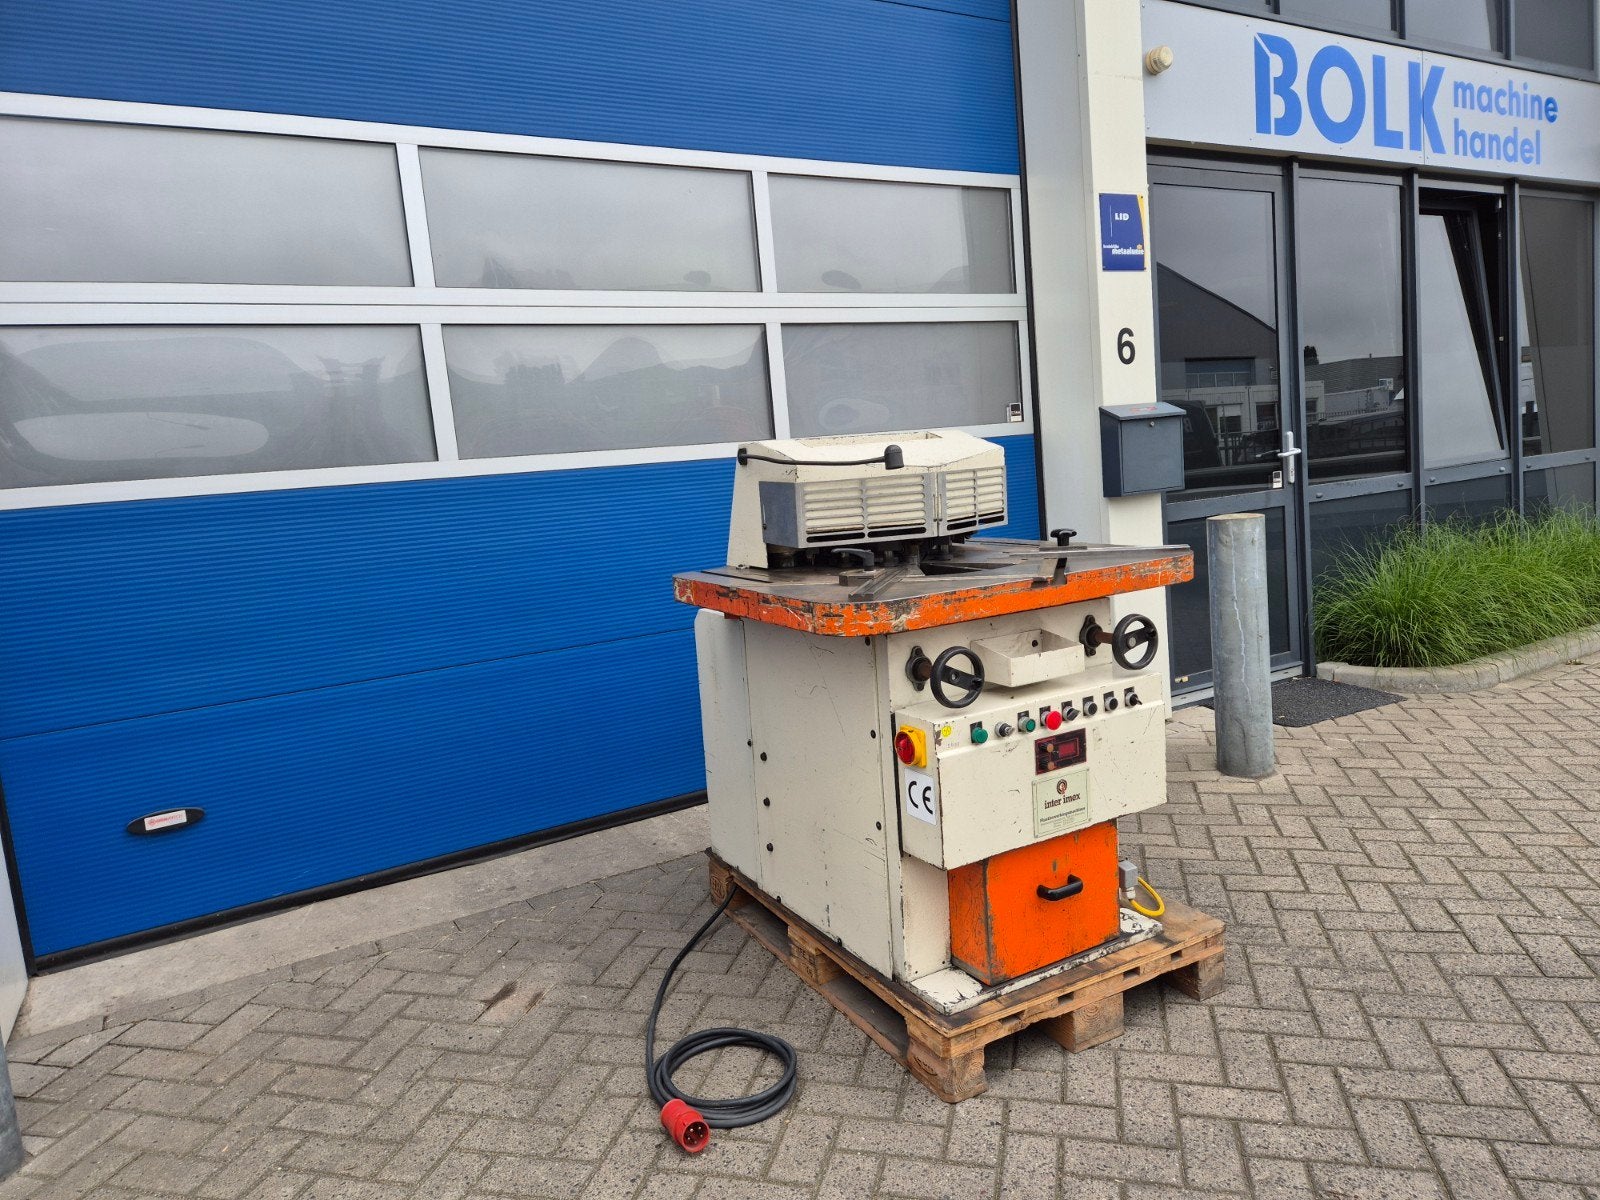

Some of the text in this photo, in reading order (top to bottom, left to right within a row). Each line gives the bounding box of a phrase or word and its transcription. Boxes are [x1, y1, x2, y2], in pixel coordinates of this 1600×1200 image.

[1254, 32, 1447, 155] BOLK
[1453, 79, 1558, 124] machine
[1453, 118, 1542, 165] handel
[1114, 212, 1130, 221] LID
[1117, 327, 1136, 365] 6
[908, 780, 934, 815] CE
[1044, 793, 1081, 810] inter imex
